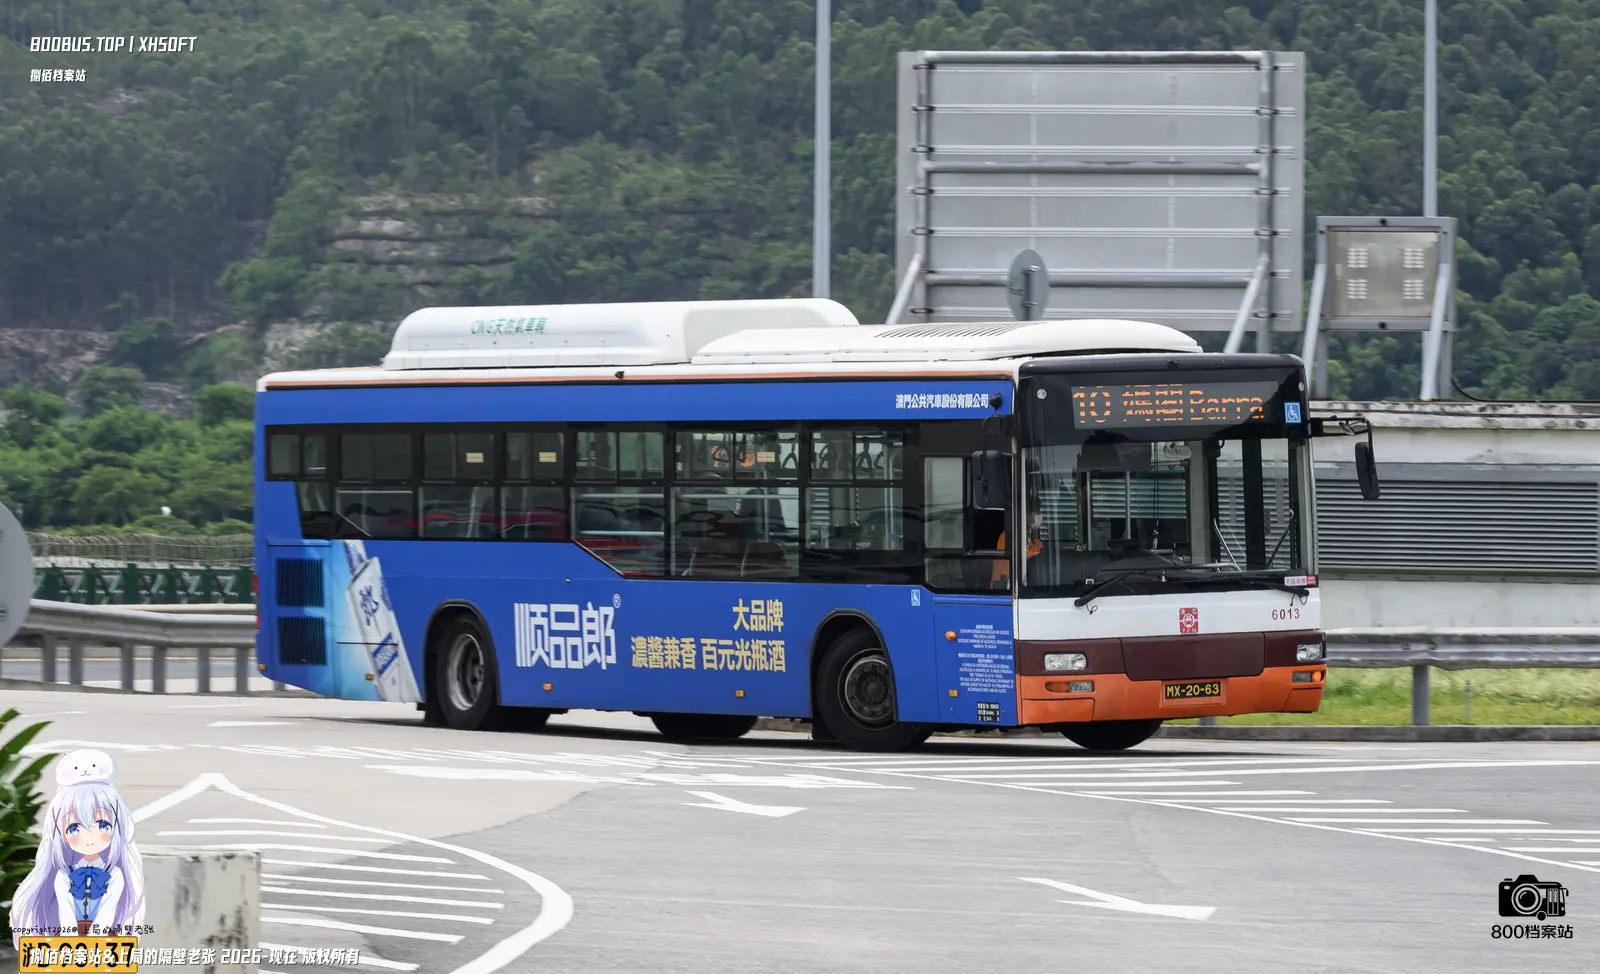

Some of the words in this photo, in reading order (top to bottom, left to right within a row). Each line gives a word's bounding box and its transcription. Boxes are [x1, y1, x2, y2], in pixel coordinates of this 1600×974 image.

[895, 393, 990, 409] 澳門公共汽車股份有限公司
[1072, 384, 1111, 424] 10
[1189, 389, 1265, 421] Barra
[732, 598, 785, 632] 大品牌
[1271, 607, 1301, 621] 6013
[513, 601, 618, 670] 顺品郎
[630, 636, 697, 670] 濃醬兼香
[700, 637, 787, 672] 百元光瓶酒
[1166, 683, 1220, 698] MX-20-63
